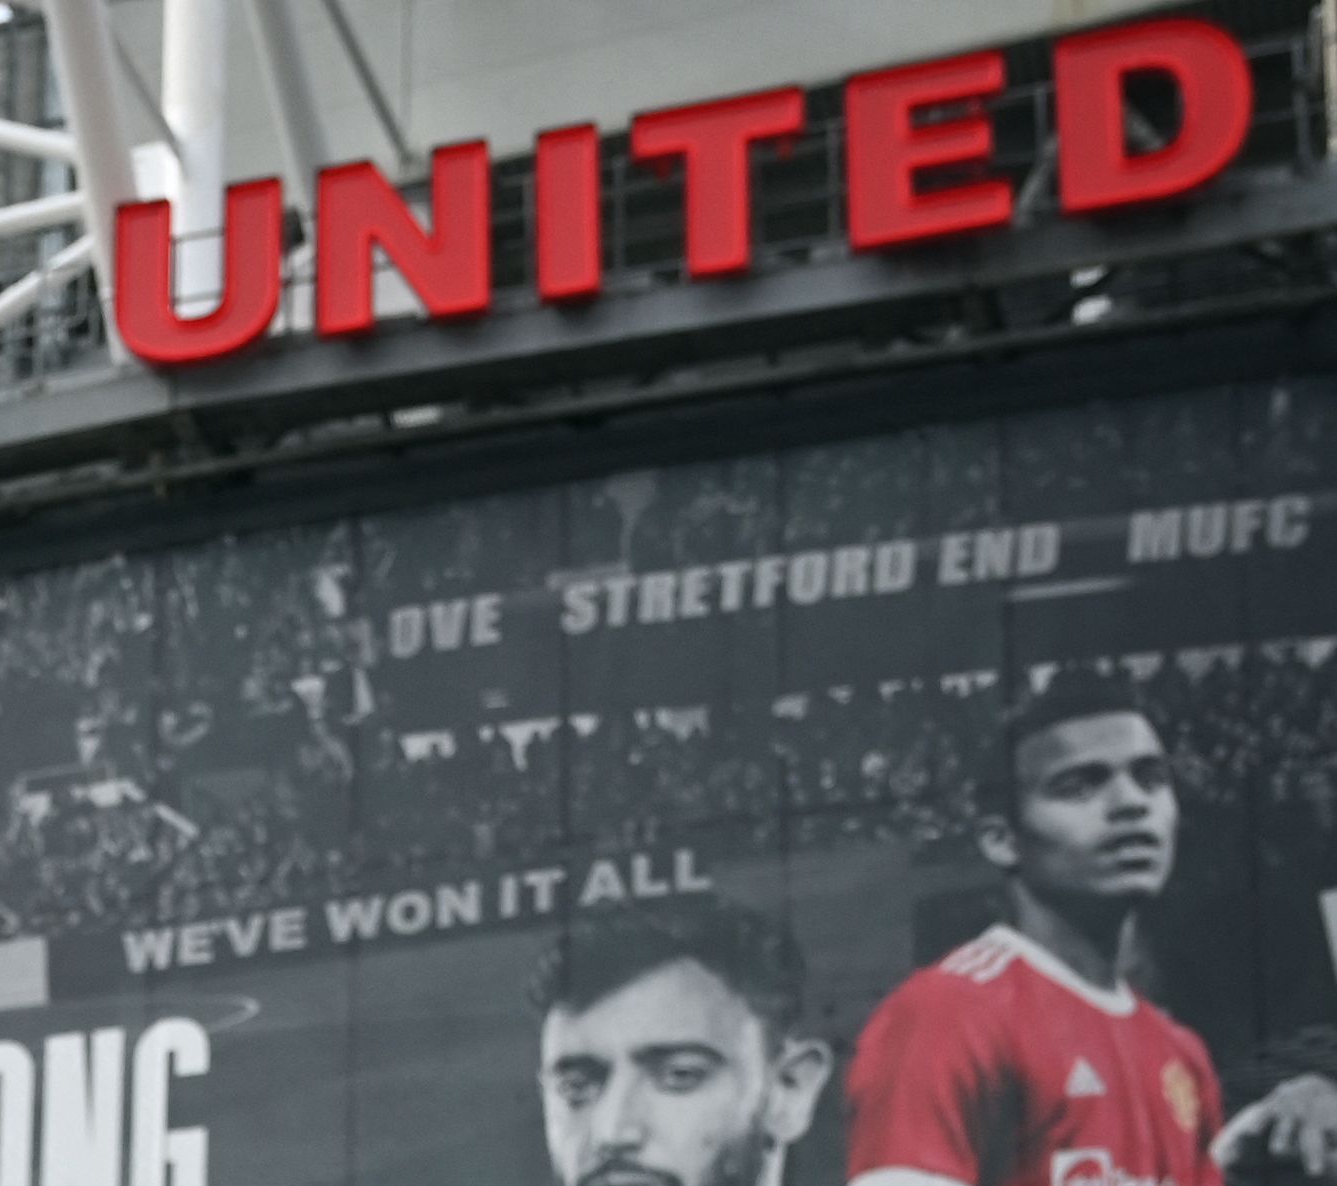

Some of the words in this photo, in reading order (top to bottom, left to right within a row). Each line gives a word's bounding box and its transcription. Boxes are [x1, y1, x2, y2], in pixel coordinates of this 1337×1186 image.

[113, 16, 1255, 364] UNITED
[559, 537, 916, 636] STRETFORD
[938, 523, 1061, 588] END
[1128, 496, 1312, 565] MUFC
[124, 907, 309, 974] WE'VE
[326, 879, 483, 943] WON
[498, 868, 566, 919] IT
[580, 848, 713, 907] ALL
